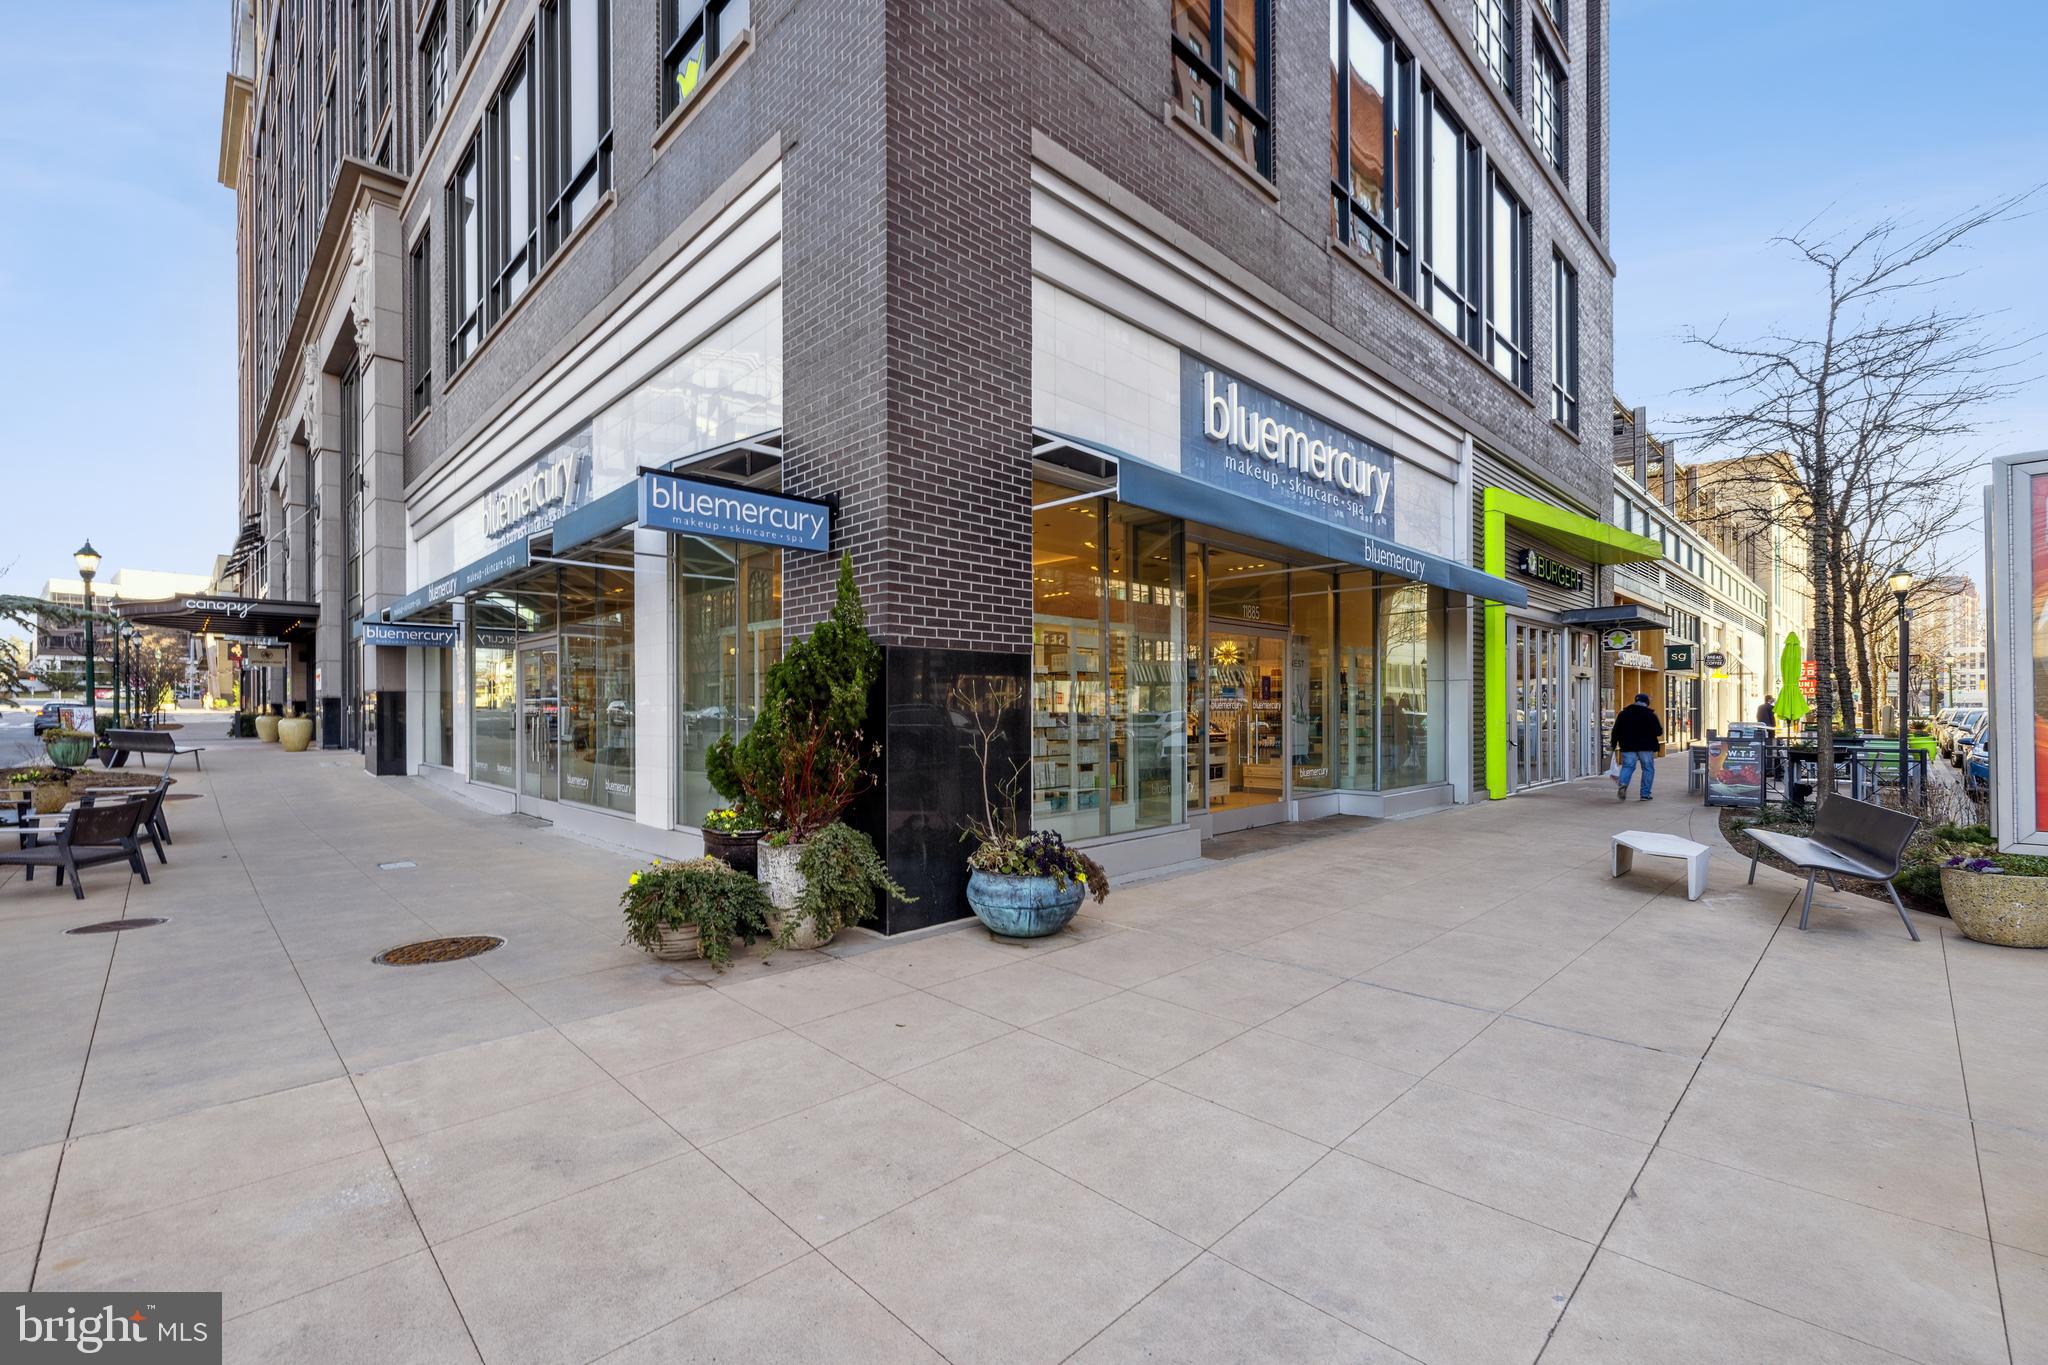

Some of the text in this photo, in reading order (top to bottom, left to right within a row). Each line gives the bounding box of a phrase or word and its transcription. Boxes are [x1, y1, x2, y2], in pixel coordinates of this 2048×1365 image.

[1204, 371, 1390, 514] bluemercury
[482, 453, 576, 538] bluemercury
[1225, 456, 1364, 518] makeup skincare spa
[652, 477, 824, 540] bluemercury
[673, 516, 803, 543] makeup skincare spa
[1364, 538, 1425, 580] bluemercury
[428, 576, 457, 602] bluemercury
[186, 599, 258, 619] canopy
[1243, 604, 1260, 620] 11885
[366, 626, 453, 644] bluemercury
[1671, 652, 1687, 662] sg
[1210, 700, 1243, 711] bluemercury
[1253, 700, 1281, 711] bluemercury
[567, 773, 589, 789] bluemercury
[1300, 767, 1328, 778] bluemercury
[605, 778, 632, 797] bluemercury
